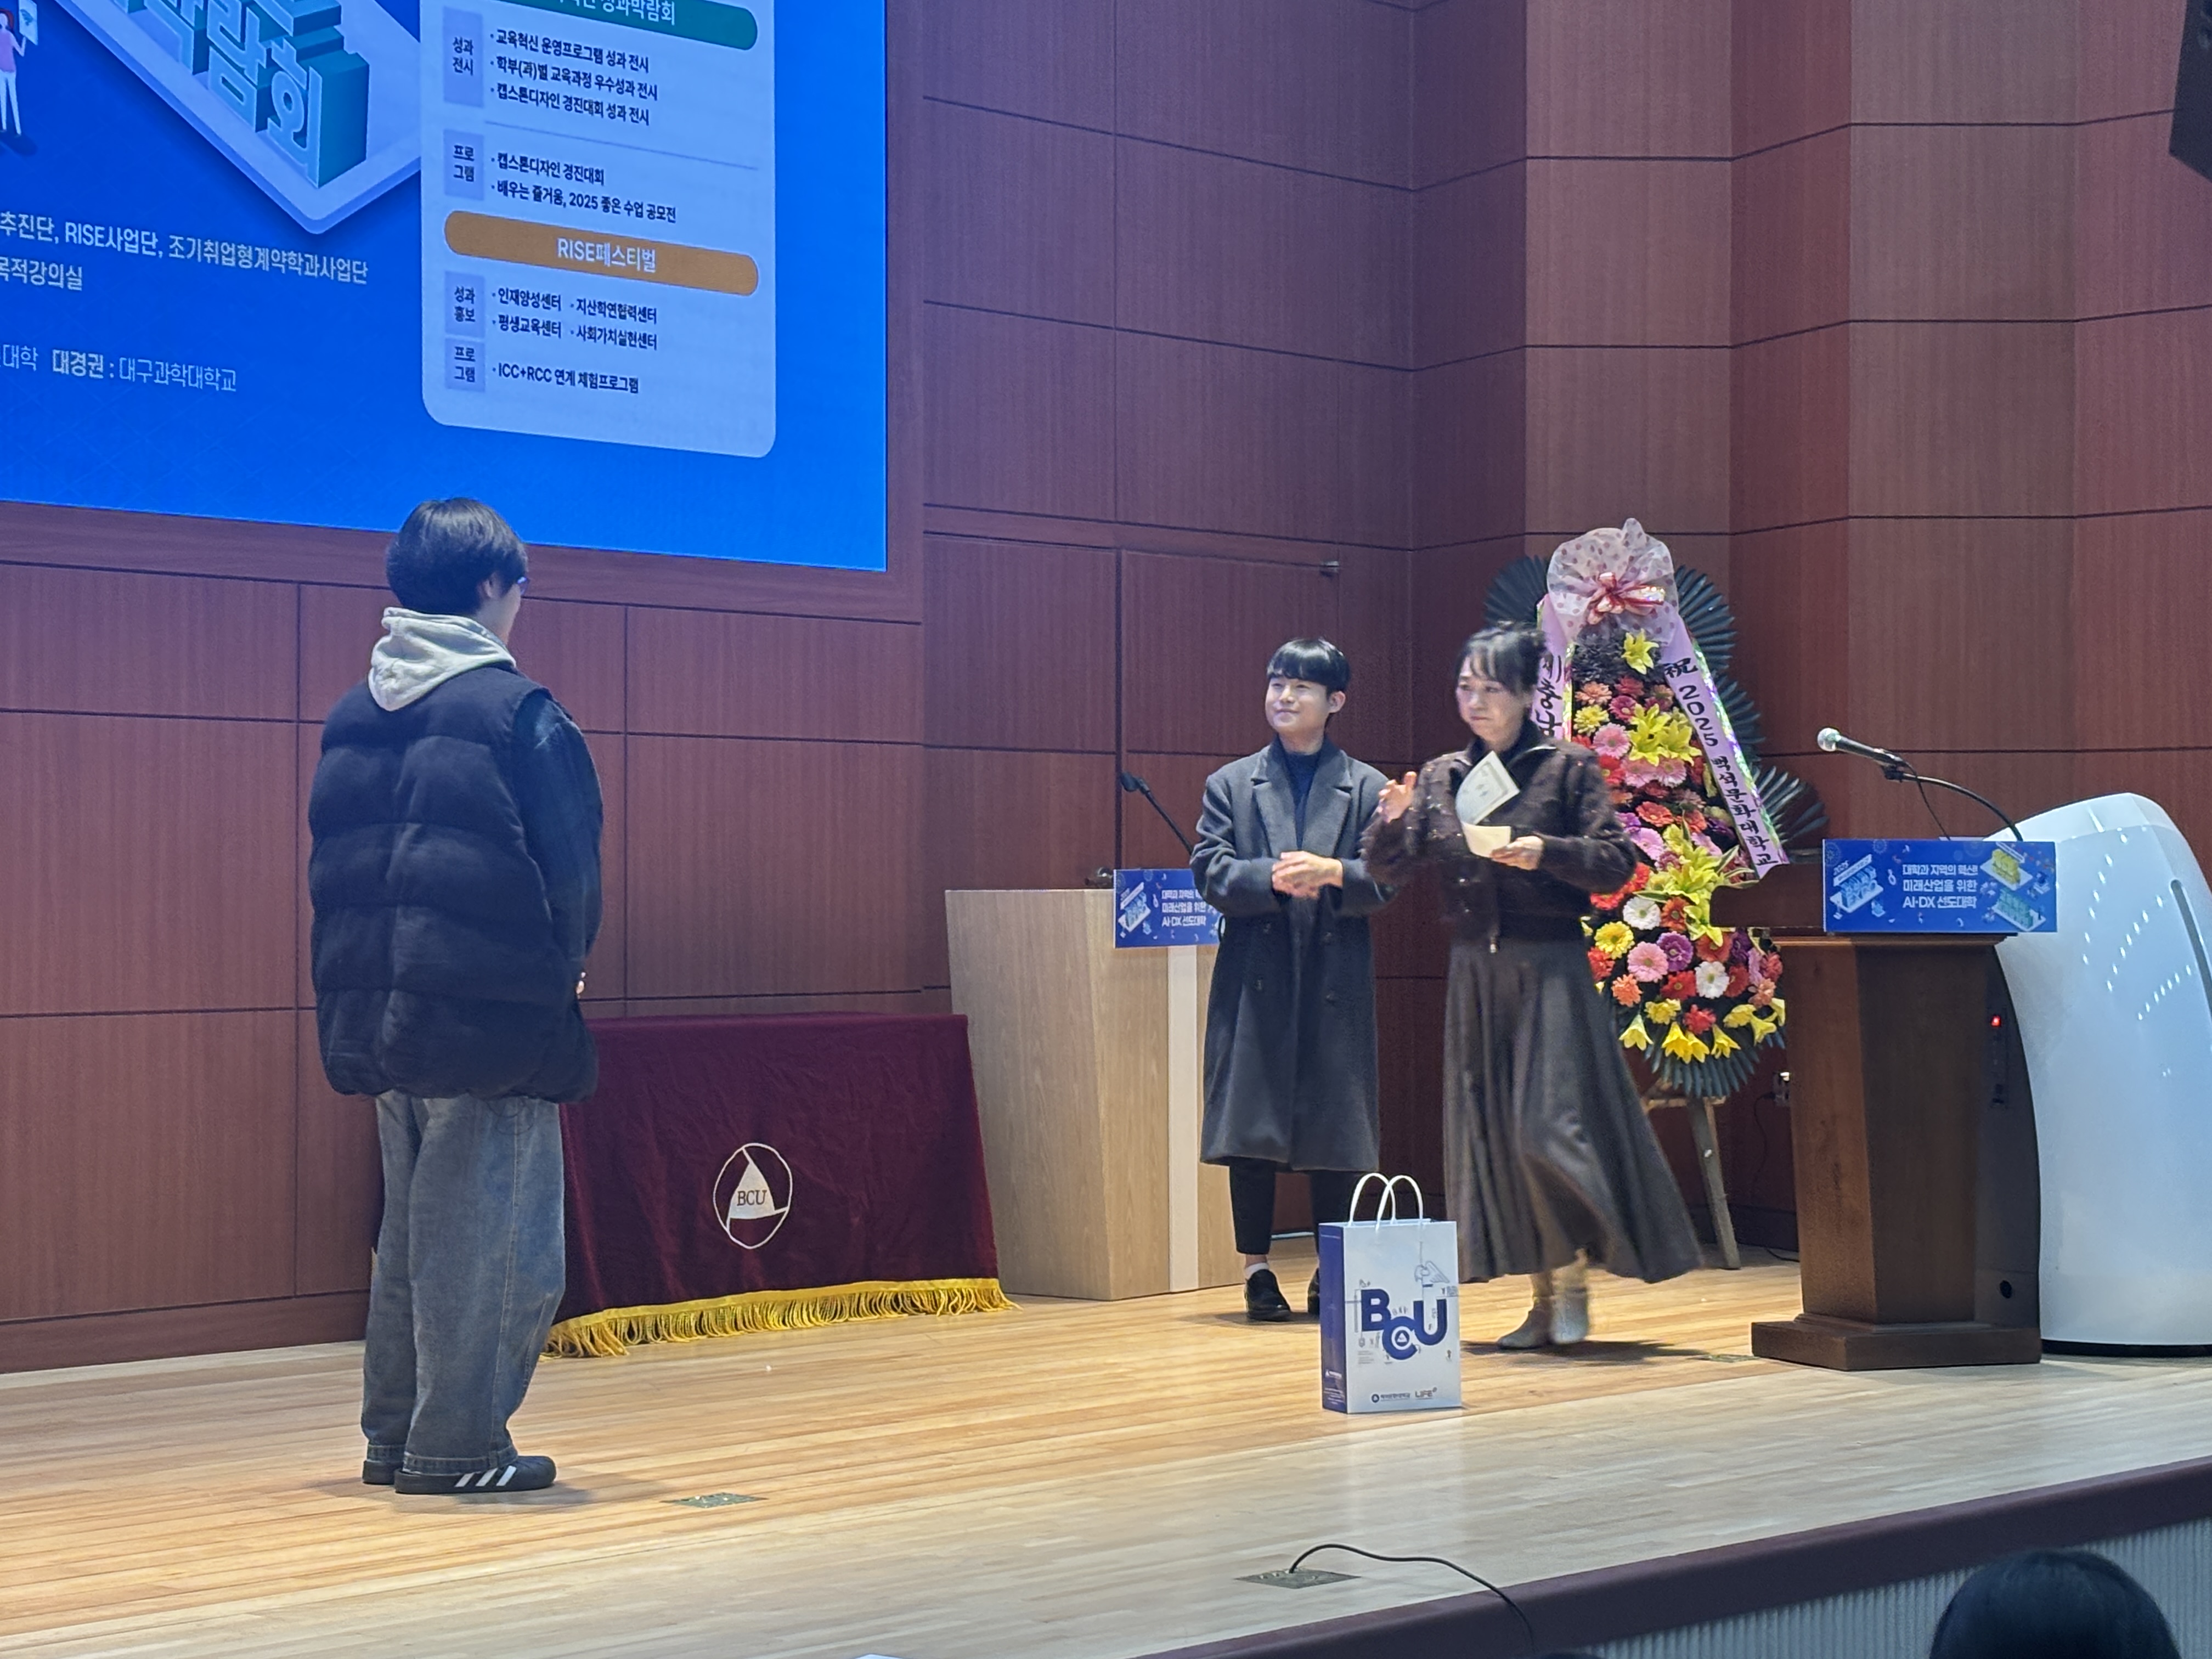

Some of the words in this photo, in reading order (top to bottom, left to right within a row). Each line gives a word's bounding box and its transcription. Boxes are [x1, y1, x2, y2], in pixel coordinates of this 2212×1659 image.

[453, 37, 473, 55] 성과
[496, 29, 538, 53] 교육혁신
[541, 38, 603, 65] 운영프로그램
[606, 50, 627, 69] 성과
[629, 54, 649, 73] 전시
[453, 57, 473, 75] 전시
[551, 66, 592, 89] 교육과정
[595, 75, 635, 97] 우수성과
[637, 82, 658, 101] 전시
[497, 83, 560, 109] 캡스톤디자인
[562, 94, 603, 119] 경진대회
[606, 103, 627, 122] 성과
[629, 108, 649, 126] 전시
[454, 145, 475, 161] 프로
[497, 153, 561, 178] 캡스톤디자인
[563, 165, 605, 185] 경진대회
[454, 165, 475, 182] 그램
[497, 180, 529, 200] 배우는
[532, 185, 566, 208] 즐거움,
[569, 192, 599, 210] 2025
[601, 196, 621, 215] 좋은
[624, 202, 644, 218] 수업
[646, 204, 676, 223] 공모전
[65, 221, 163, 258] RISE사업단,
[168, 235, 369, 285] 조기취업형계약학과사업단
[557, 238, 657, 273] RISE페스티벌
[454, 286, 475, 304] 성과
[498, 287, 562, 311] 인재양성센터
[576, 298, 658, 325] 지산학연협력센터
[454, 306, 476, 323] 홍보
[498, 314, 562, 338] 평생교육센터
[576, 325, 658, 351] 사회가치실현센터
[454, 346, 476, 362] 프로
[52, 349, 104, 379] 대경권
[119, 357, 236, 392] 대구과학대학교
[454, 366, 476, 383] 그램
[498, 363, 552, 383] ICC+RCC
[554, 369, 575, 386] 연계
[578, 371, 639, 394] 체험프로그램
[1663, 657, 1699, 679] 祝
[1679, 685, 1718, 747] 2025
[1711, 756, 1779, 866] 백석문화대학교
[1903, 879, 1955, 893] 미래산업을
[1956, 879, 1978, 893] 위한
[737, 1189, 768, 1206] BCU
[1361, 1289, 1448, 1360] BCU
